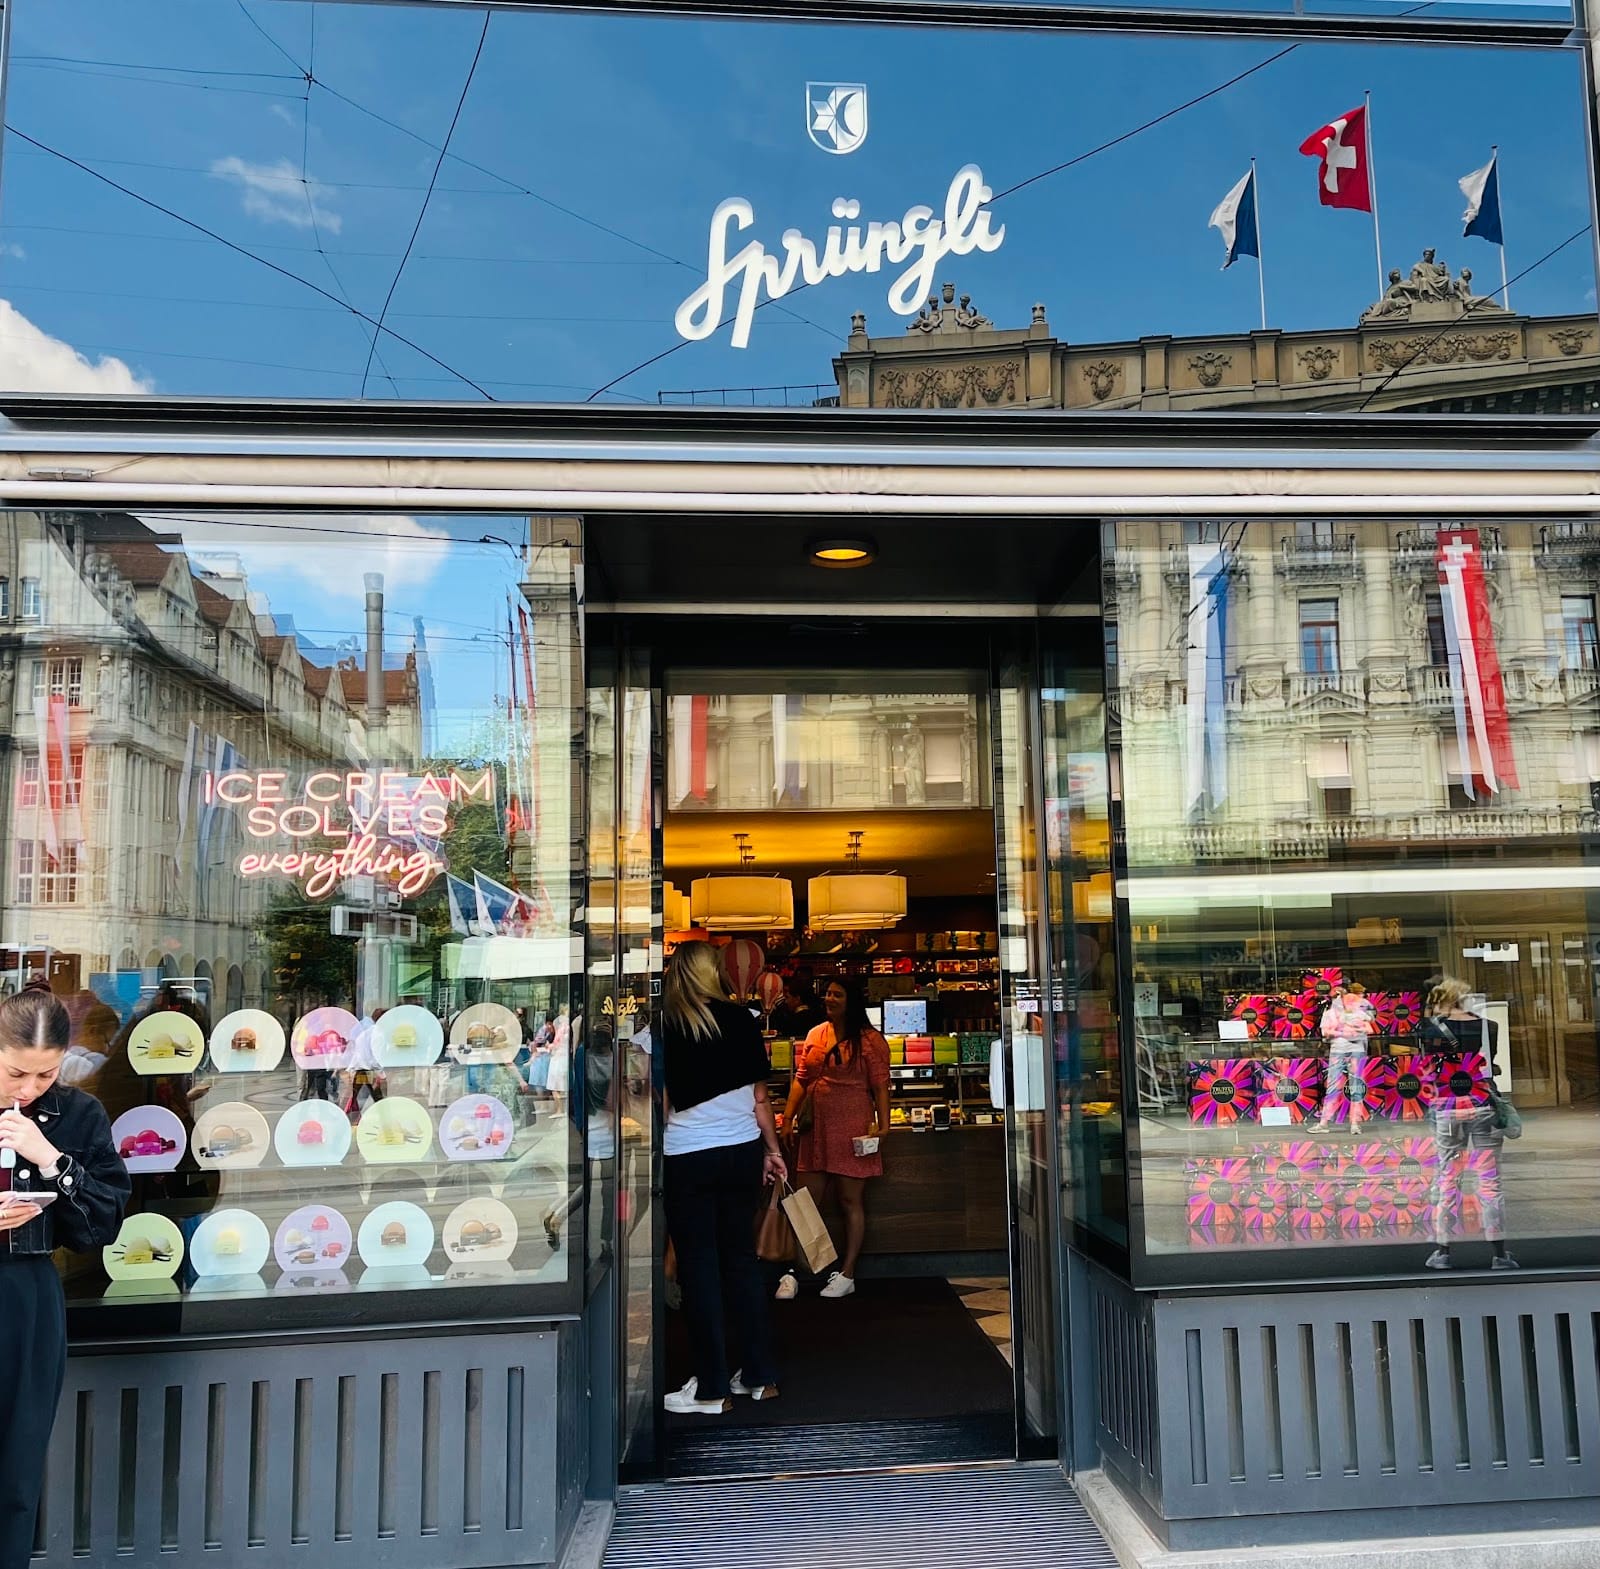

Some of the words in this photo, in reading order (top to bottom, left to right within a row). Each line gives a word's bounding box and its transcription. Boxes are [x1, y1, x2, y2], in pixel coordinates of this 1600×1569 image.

[674, 163, 1006, 349] Sprüngli
[204, 770, 287, 804] ICE
[305, 771, 492, 803] CREAM
[247, 804, 449, 837] SOLVES
[239, 833, 444, 898] everything
